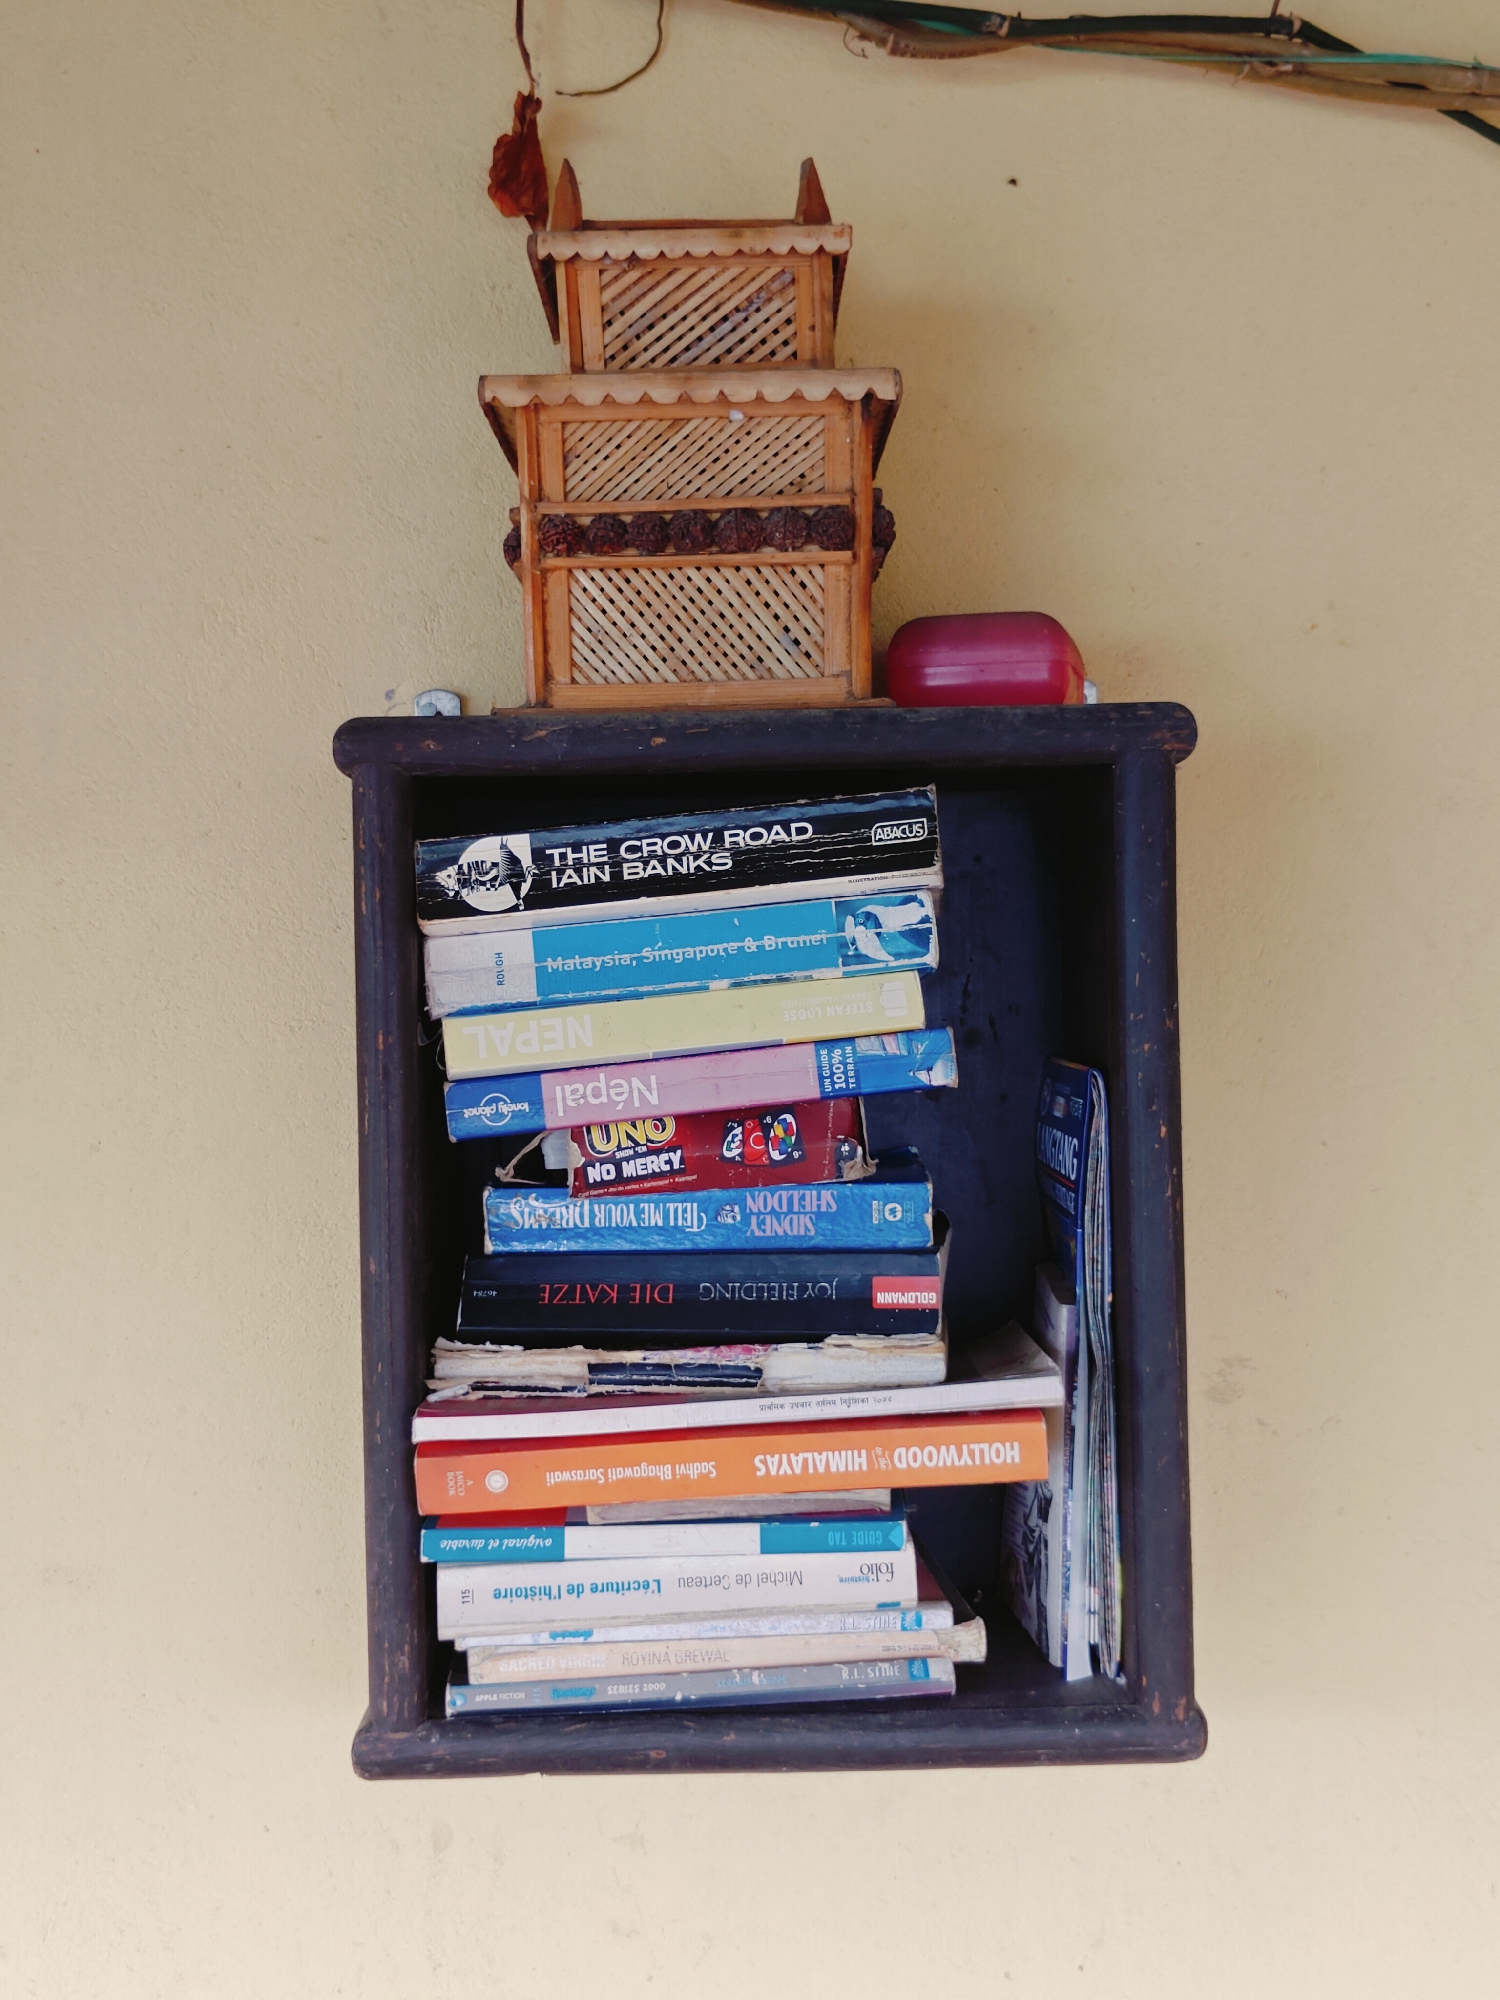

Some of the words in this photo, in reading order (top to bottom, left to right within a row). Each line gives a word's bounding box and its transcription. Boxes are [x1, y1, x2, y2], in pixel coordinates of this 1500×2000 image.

[875, 823, 924, 842] ABACUS
[545, 843, 607, 867] THE
[619, 832, 714, 860] CROW
[723, 821, 813, 849] ROAD
[551, 864, 611, 889] IAIN
[622, 852, 733, 881] BANKS
[546, 950, 637, 973] Malaysia,
[642, 940, 738, 964] Singapore
[743, 936, 759, 953] &
[763, 929, 828, 951] Brunei
[782, 1006, 822, 1022] LOOSE
[826, 1001, 874, 1017] STEFAN
[461, 1013, 595, 1059] NEPAL
[820, 1047, 831, 1077] GUIDE
[832, 1047, 847, 1090] 100%
[844, 1045, 857, 1089] TERRAIN
[554, 1072, 660, 1117] Népal
[823, 1077, 833, 1093] UN
[462, 1102, 497, 1119] planet
[498, 1101, 530, 1117] lonely
[583, 1115, 676, 1158] UNO
[614, 1149, 635, 1159] SHOW
[586, 1161, 617, 1184] NO
[621, 1148, 683, 1178] MERCY
[745, 1189, 838, 1214] SHELDON
[509, 1195, 590, 1230] DREAMS
[593, 1203, 640, 1229] YOUR
[640, 1202, 664, 1228] ME
[665, 1202, 708, 1232] TELL
[745, 1213, 816, 1237] SIDNEY
[472, 1289, 498, 1297] 46784
[538, 1282, 619, 1305] KATZE
[628, 1282, 674, 1304] DIE
[698, 1281, 801, 1301] FIELDING
[802, 1277, 839, 1301] JOY
[876, 1289, 937, 1305] GOLDMANN
[753, 1448, 868, 1477] HIMALAYAS
[893, 1441, 1021, 1469] HOLLYWOOD
[546, 1467, 604, 1487] Saraswati
[608, 1461, 672, 1484] Bhagawati
[675, 1460, 717, 1478] Sadhvi
[446, 1471, 456, 1498] BOOK
[439, 1537, 486, 1551] durable
[488, 1537, 500, 1550] et
[502, 1533, 553, 1550] original
[827, 1530, 846, 1546] TAO
[851, 1530, 883, 1546] GUIDE
[678, 1572, 731, 1590] Certeau
[735, 1572, 752, 1587] de
[756, 1569, 803, 1587] Michel
[859, 1561, 895, 1583] folio
[461, 1588, 471, 1605] 115
[493, 1584, 562, 1603] l'histoire
[566, 1582, 585, 1598] de
[589, 1577, 662, 1597] L'écriture
[864, 1614, 898, 1630] STINE
[841, 1668, 865, 1681] R.L.
[867, 1664, 901, 1679] STINE
[475, 1692, 498, 1702] APPLE
[498, 1690, 526, 1700] FICTION
[607, 1682, 640, 1695] SERIES
[642, 1681, 667, 1693] 2000
